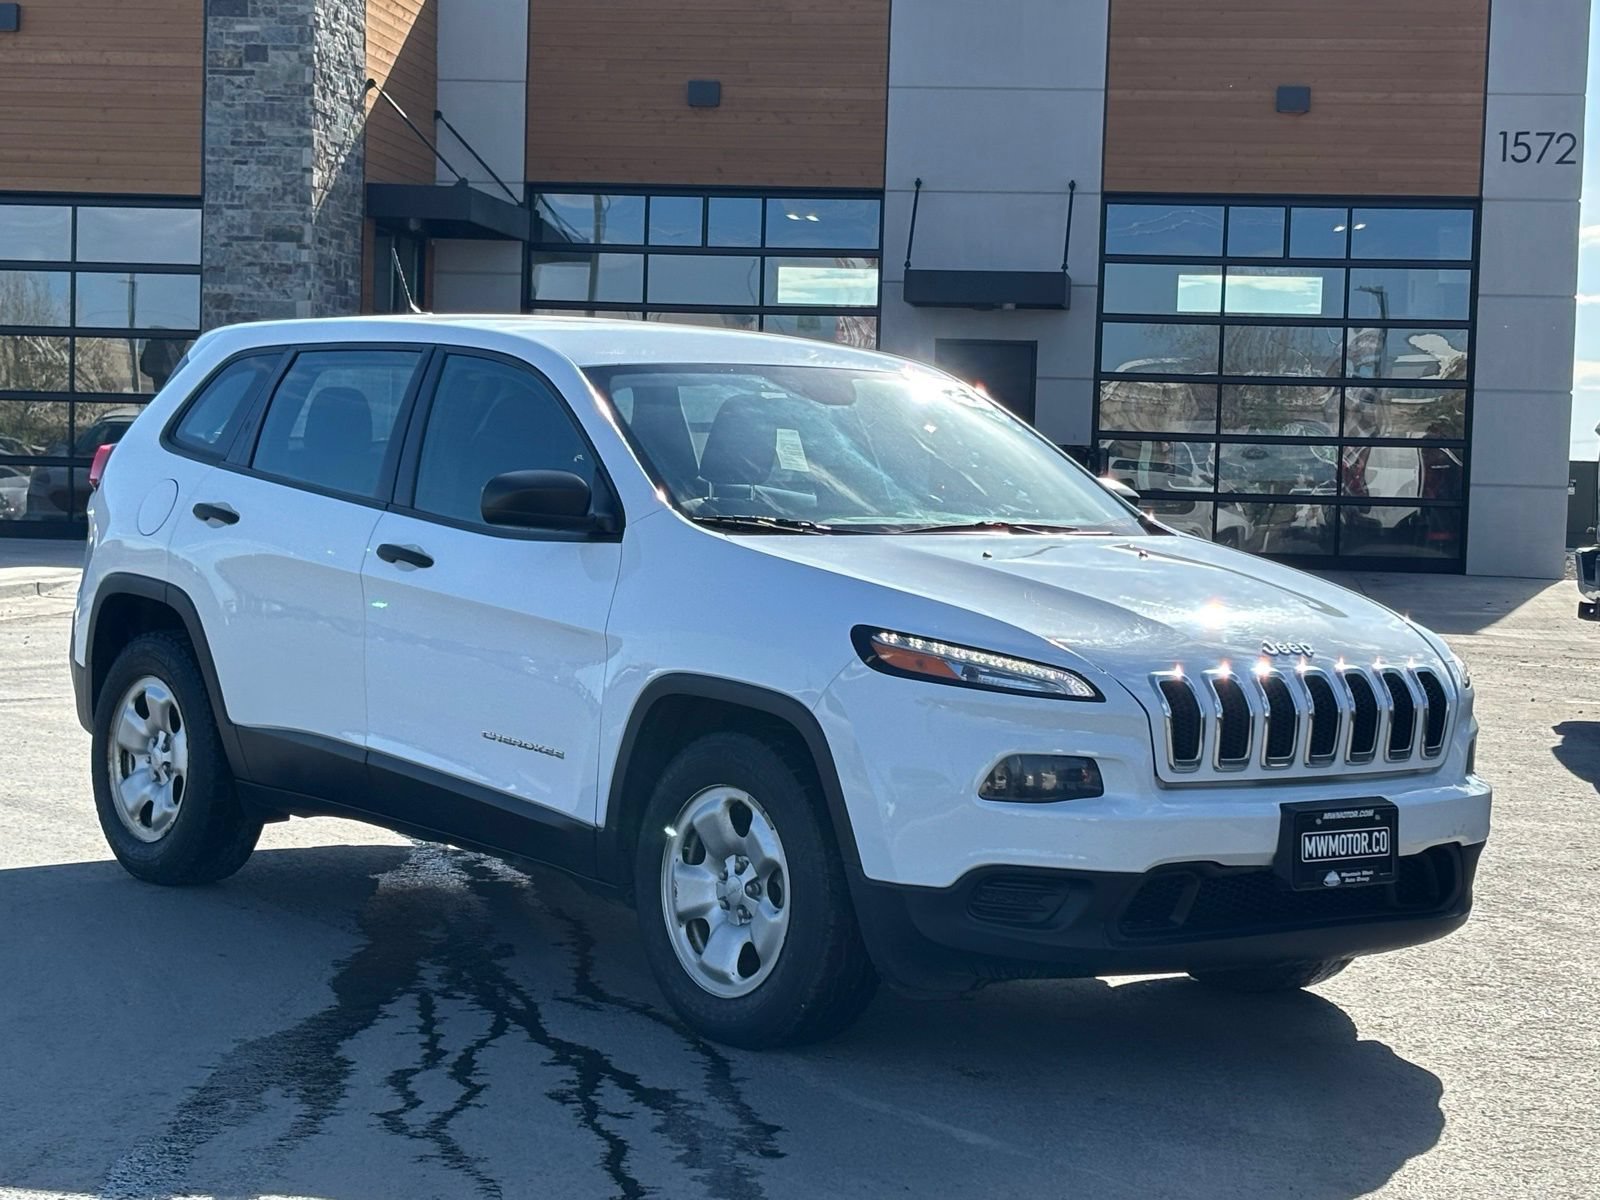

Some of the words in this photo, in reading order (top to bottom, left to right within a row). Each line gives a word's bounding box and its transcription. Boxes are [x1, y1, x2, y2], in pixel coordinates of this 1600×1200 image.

[1499, 131, 1577, 165] 1572
[1262, 640, 1314, 657] Jeep
[482, 730, 565, 760] CHEROKEE
[1304, 831, 1387, 858] MWMOTOR.CO
